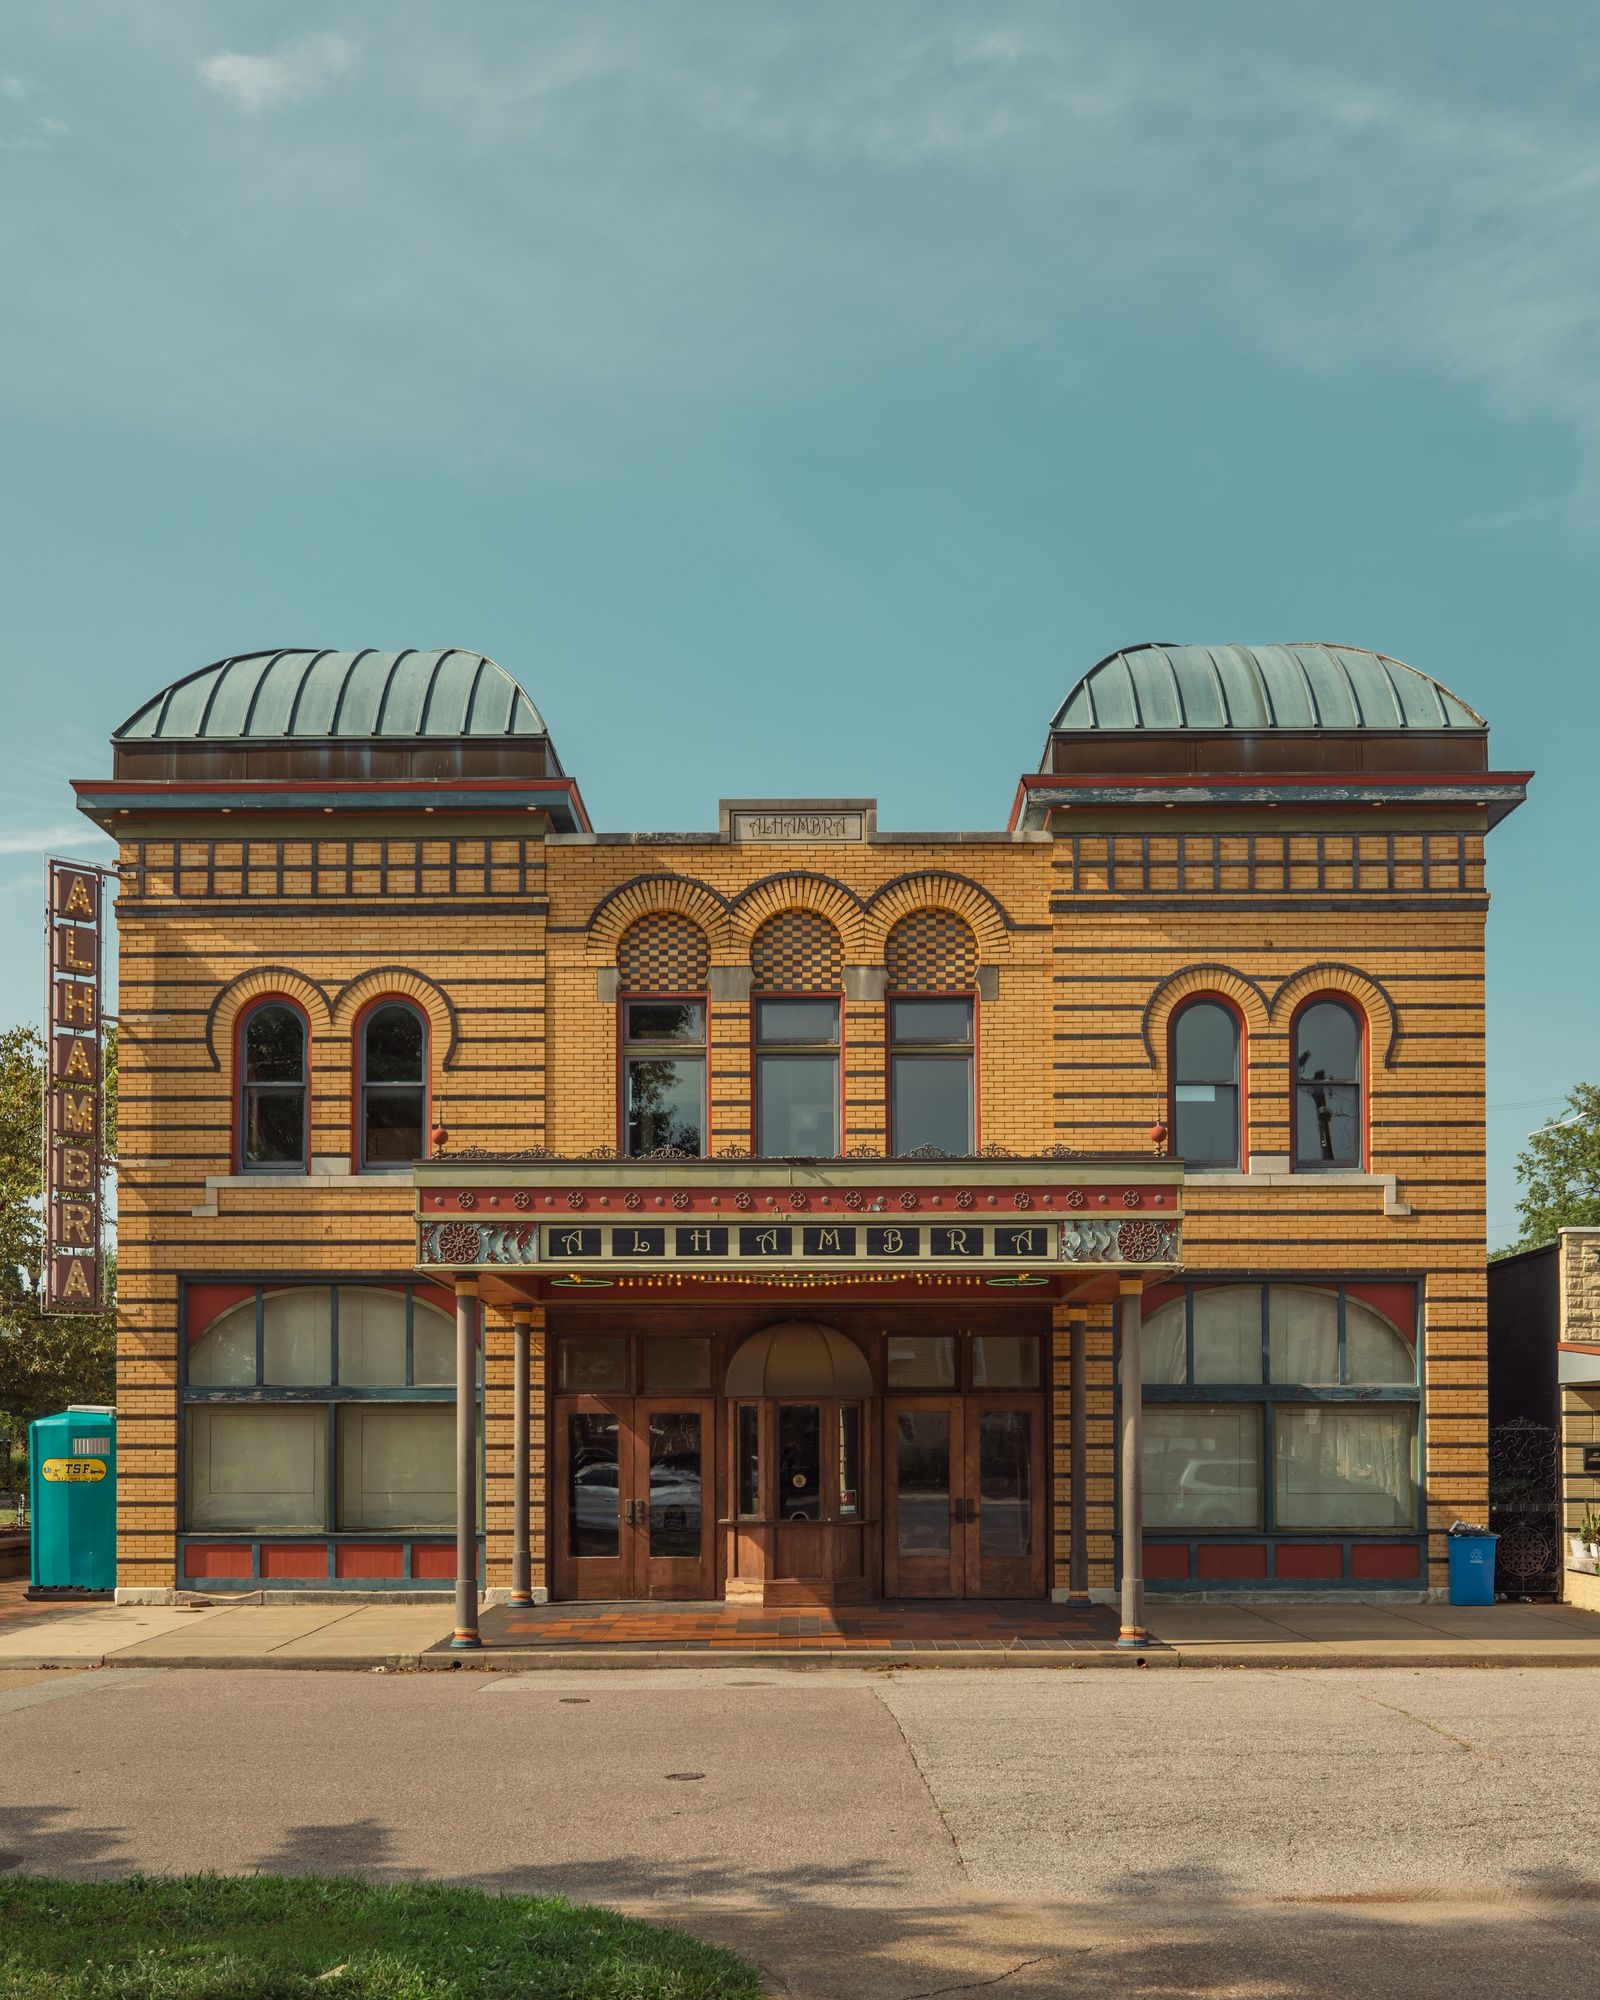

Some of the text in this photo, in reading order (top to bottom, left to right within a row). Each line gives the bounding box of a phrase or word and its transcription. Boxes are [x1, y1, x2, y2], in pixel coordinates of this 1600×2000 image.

[749, 816, 846, 837] ALHAMBRA
[62, 874, 94, 1299] ALHAMBRA
[561, 1228, 1033, 1255] ALHAMBRA
[65, 1463, 90, 1474] TSF
